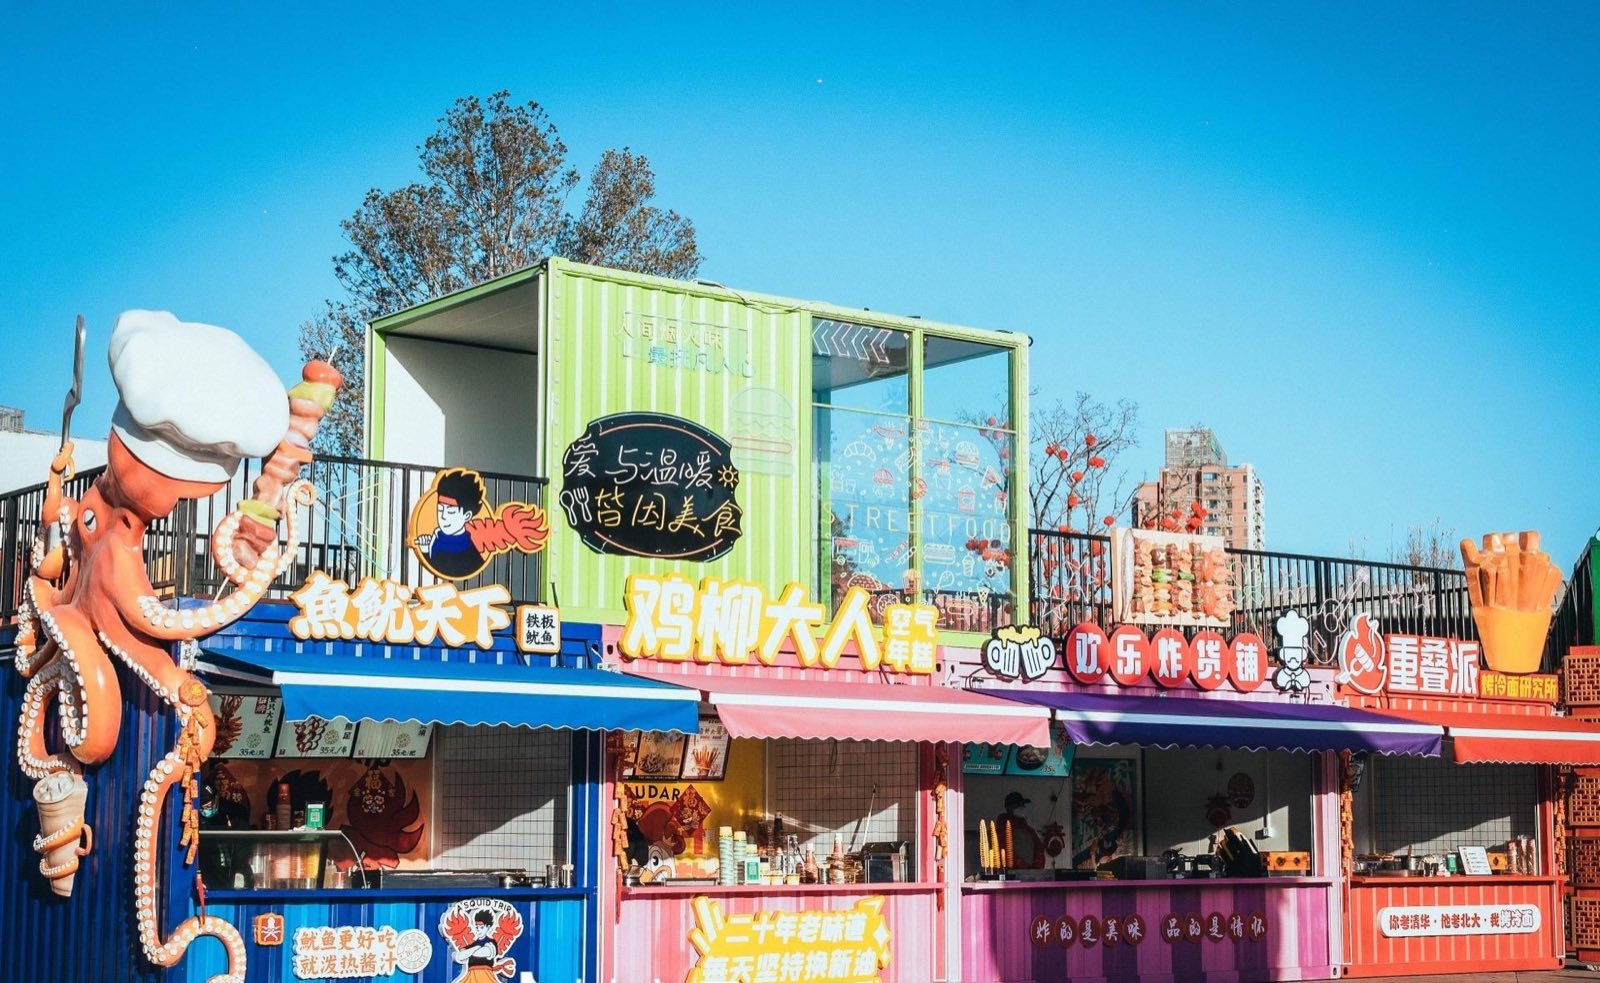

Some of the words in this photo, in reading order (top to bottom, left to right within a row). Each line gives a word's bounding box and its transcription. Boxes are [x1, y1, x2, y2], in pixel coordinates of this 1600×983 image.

[595, 486, 743, 537] 皆因美食
[526, 612, 556, 629] 铁板
[625, 577, 881, 670] 鸡柳大人
[890, 608, 936, 637] 空气
[525, 629, 555, 646] 鱿鱼
[888, 640, 935, 669] 年糕
[1076, 632, 1259, 682] 欢乐炸货铺
[1388, 636, 1479, 695] 重叠派
[1481, 673, 1557, 699] 烤冷面研究所
[464, 899, 492, 909] SQUID
[494, 901, 512, 912] TRIP
[300, 929, 397, 951] 鱿鱼更好吃
[725, 912, 868, 945] 二十年老味道
[1036, 919, 1143, 943] 炸的是美味
[1166, 917, 1266, 938] 品的是情怀
[300, 952, 398, 975] 就泼热酱汁
[703, 948, 877, 982] 每天坚持换新油
